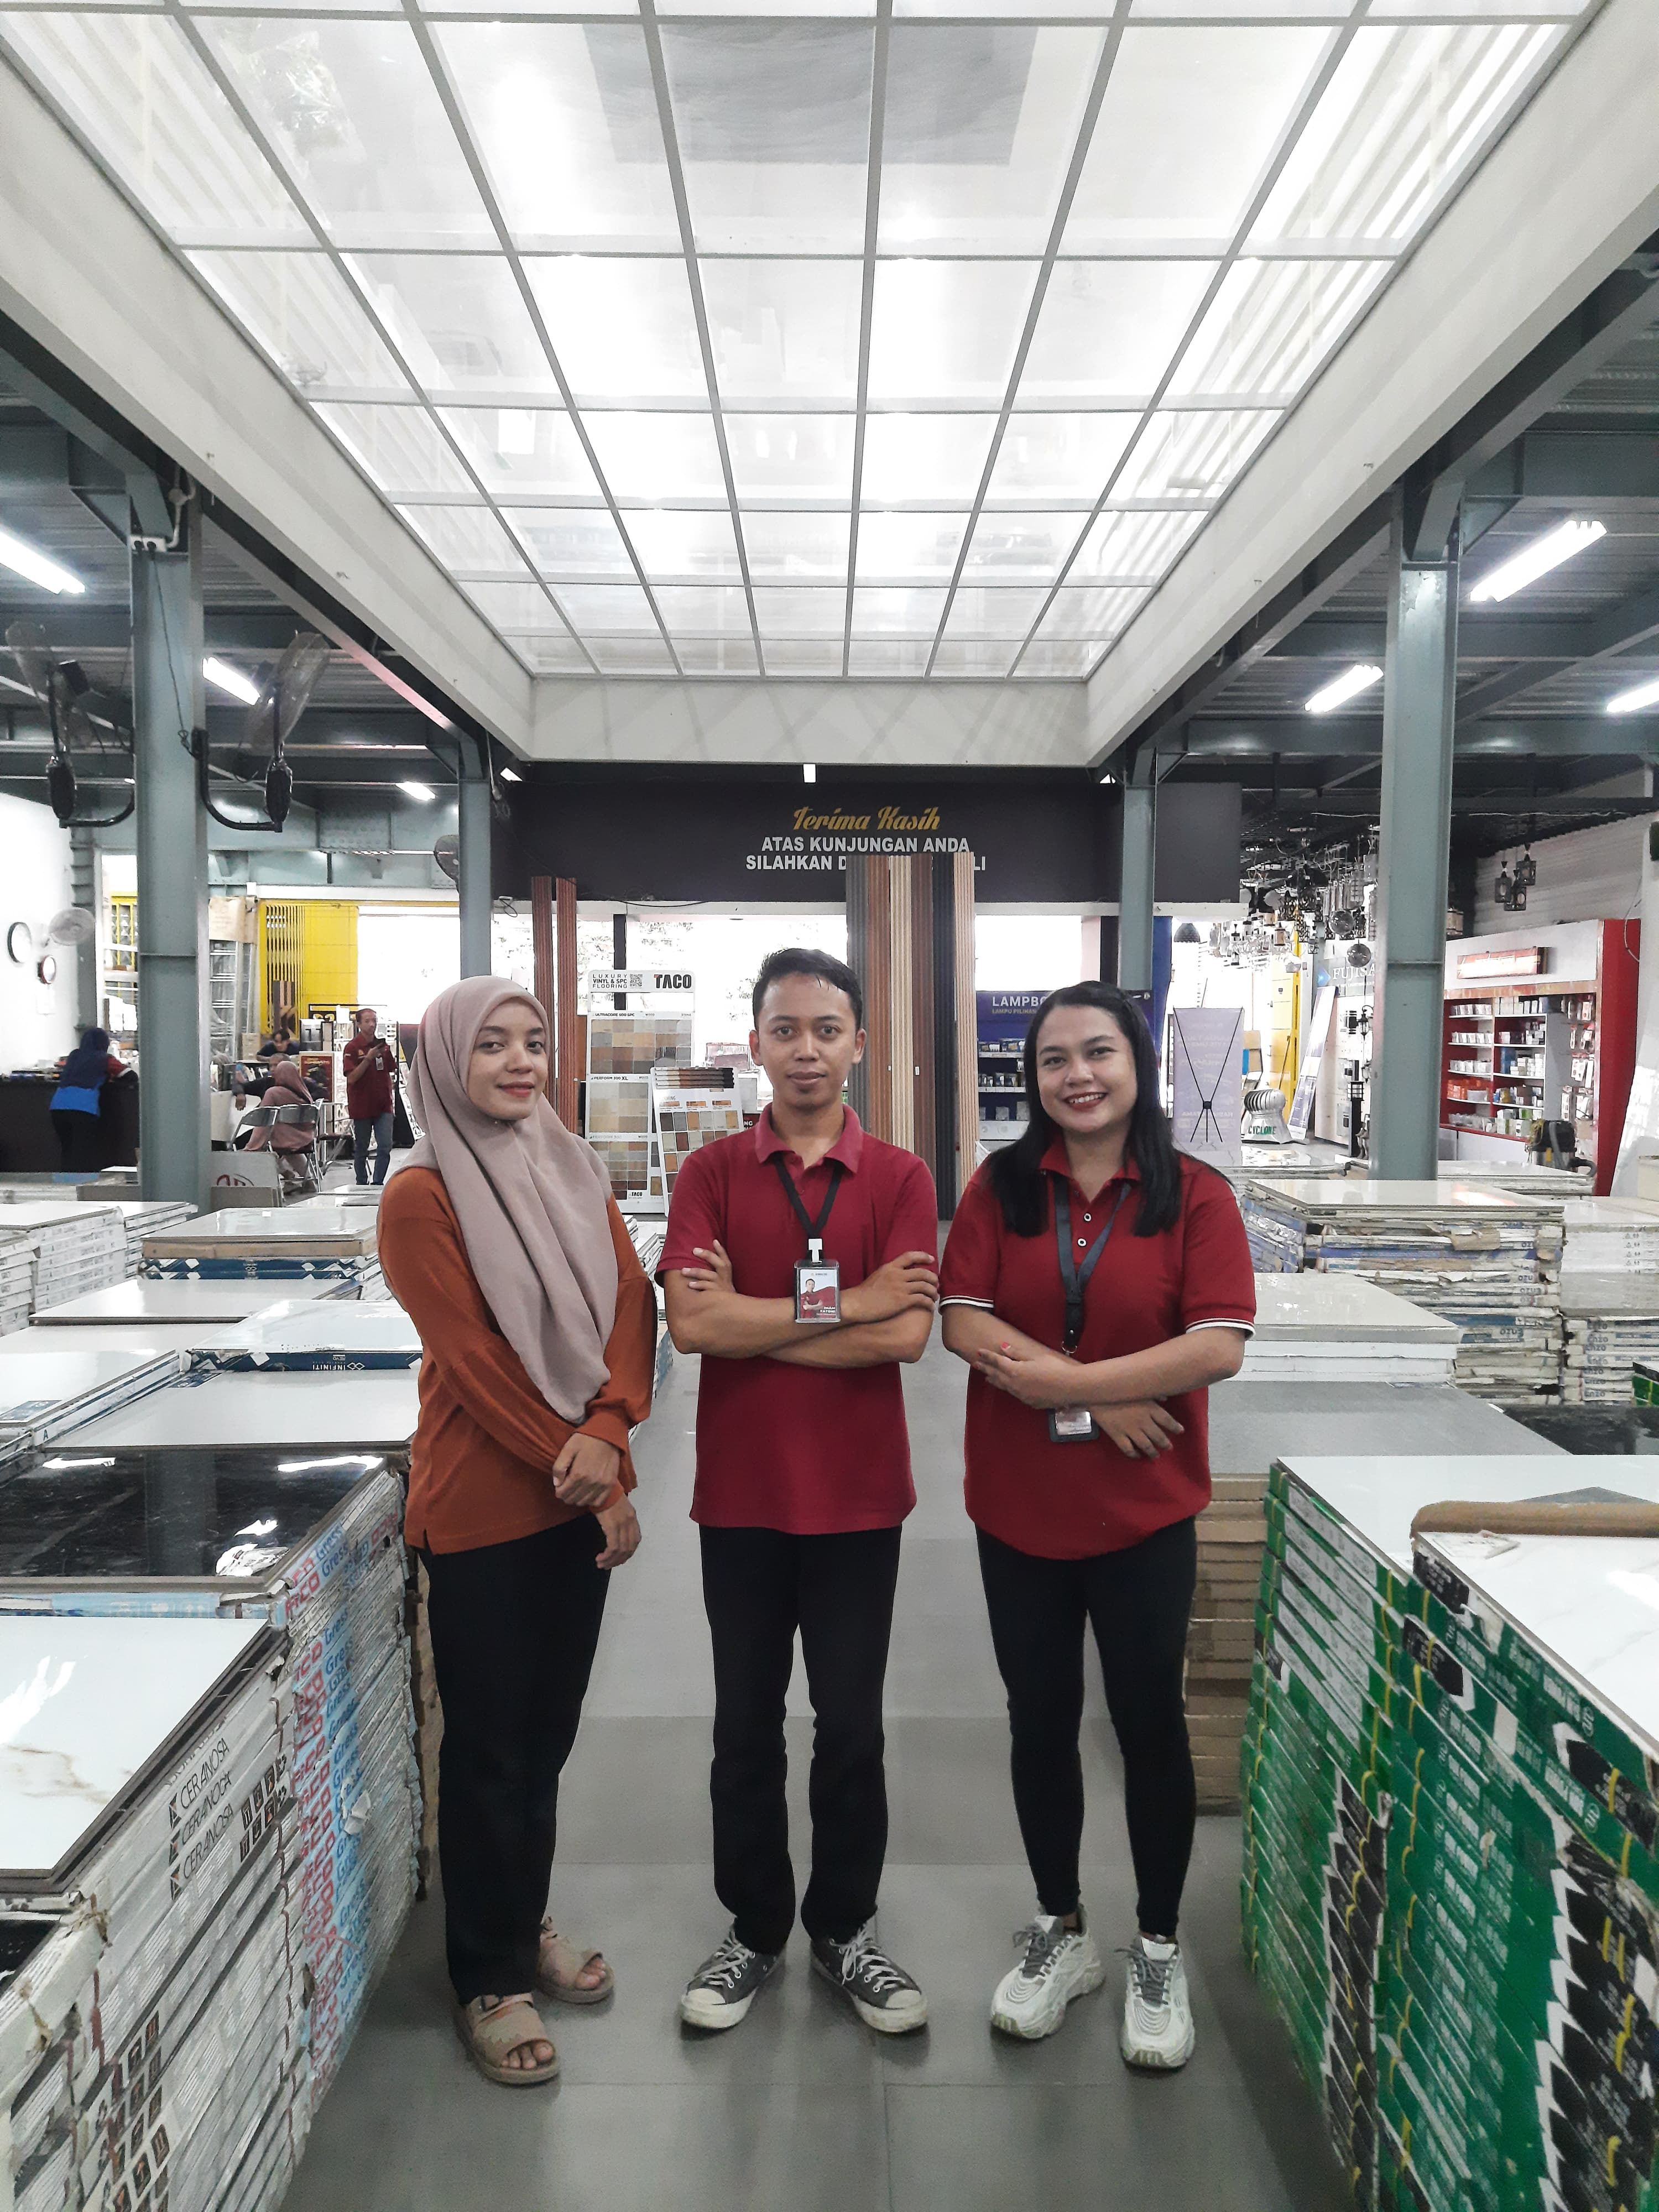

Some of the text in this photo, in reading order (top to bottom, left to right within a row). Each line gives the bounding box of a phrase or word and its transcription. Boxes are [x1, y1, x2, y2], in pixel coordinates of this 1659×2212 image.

[793, 806, 941, 830] Terima Kasih
[761, 837, 970, 853] ATAS KUNJUNGAN ANDA
[745, 855, 832, 870] SILAHKAN
[654, 974, 692, 989] TACO
[1248, 1125, 1277, 1135] CYCLONE
[322, 1542, 348, 1577] Gress
[180, 1738, 230, 1809] CERANOSA
[183, 1803, 233, 1880] CERANOSA
